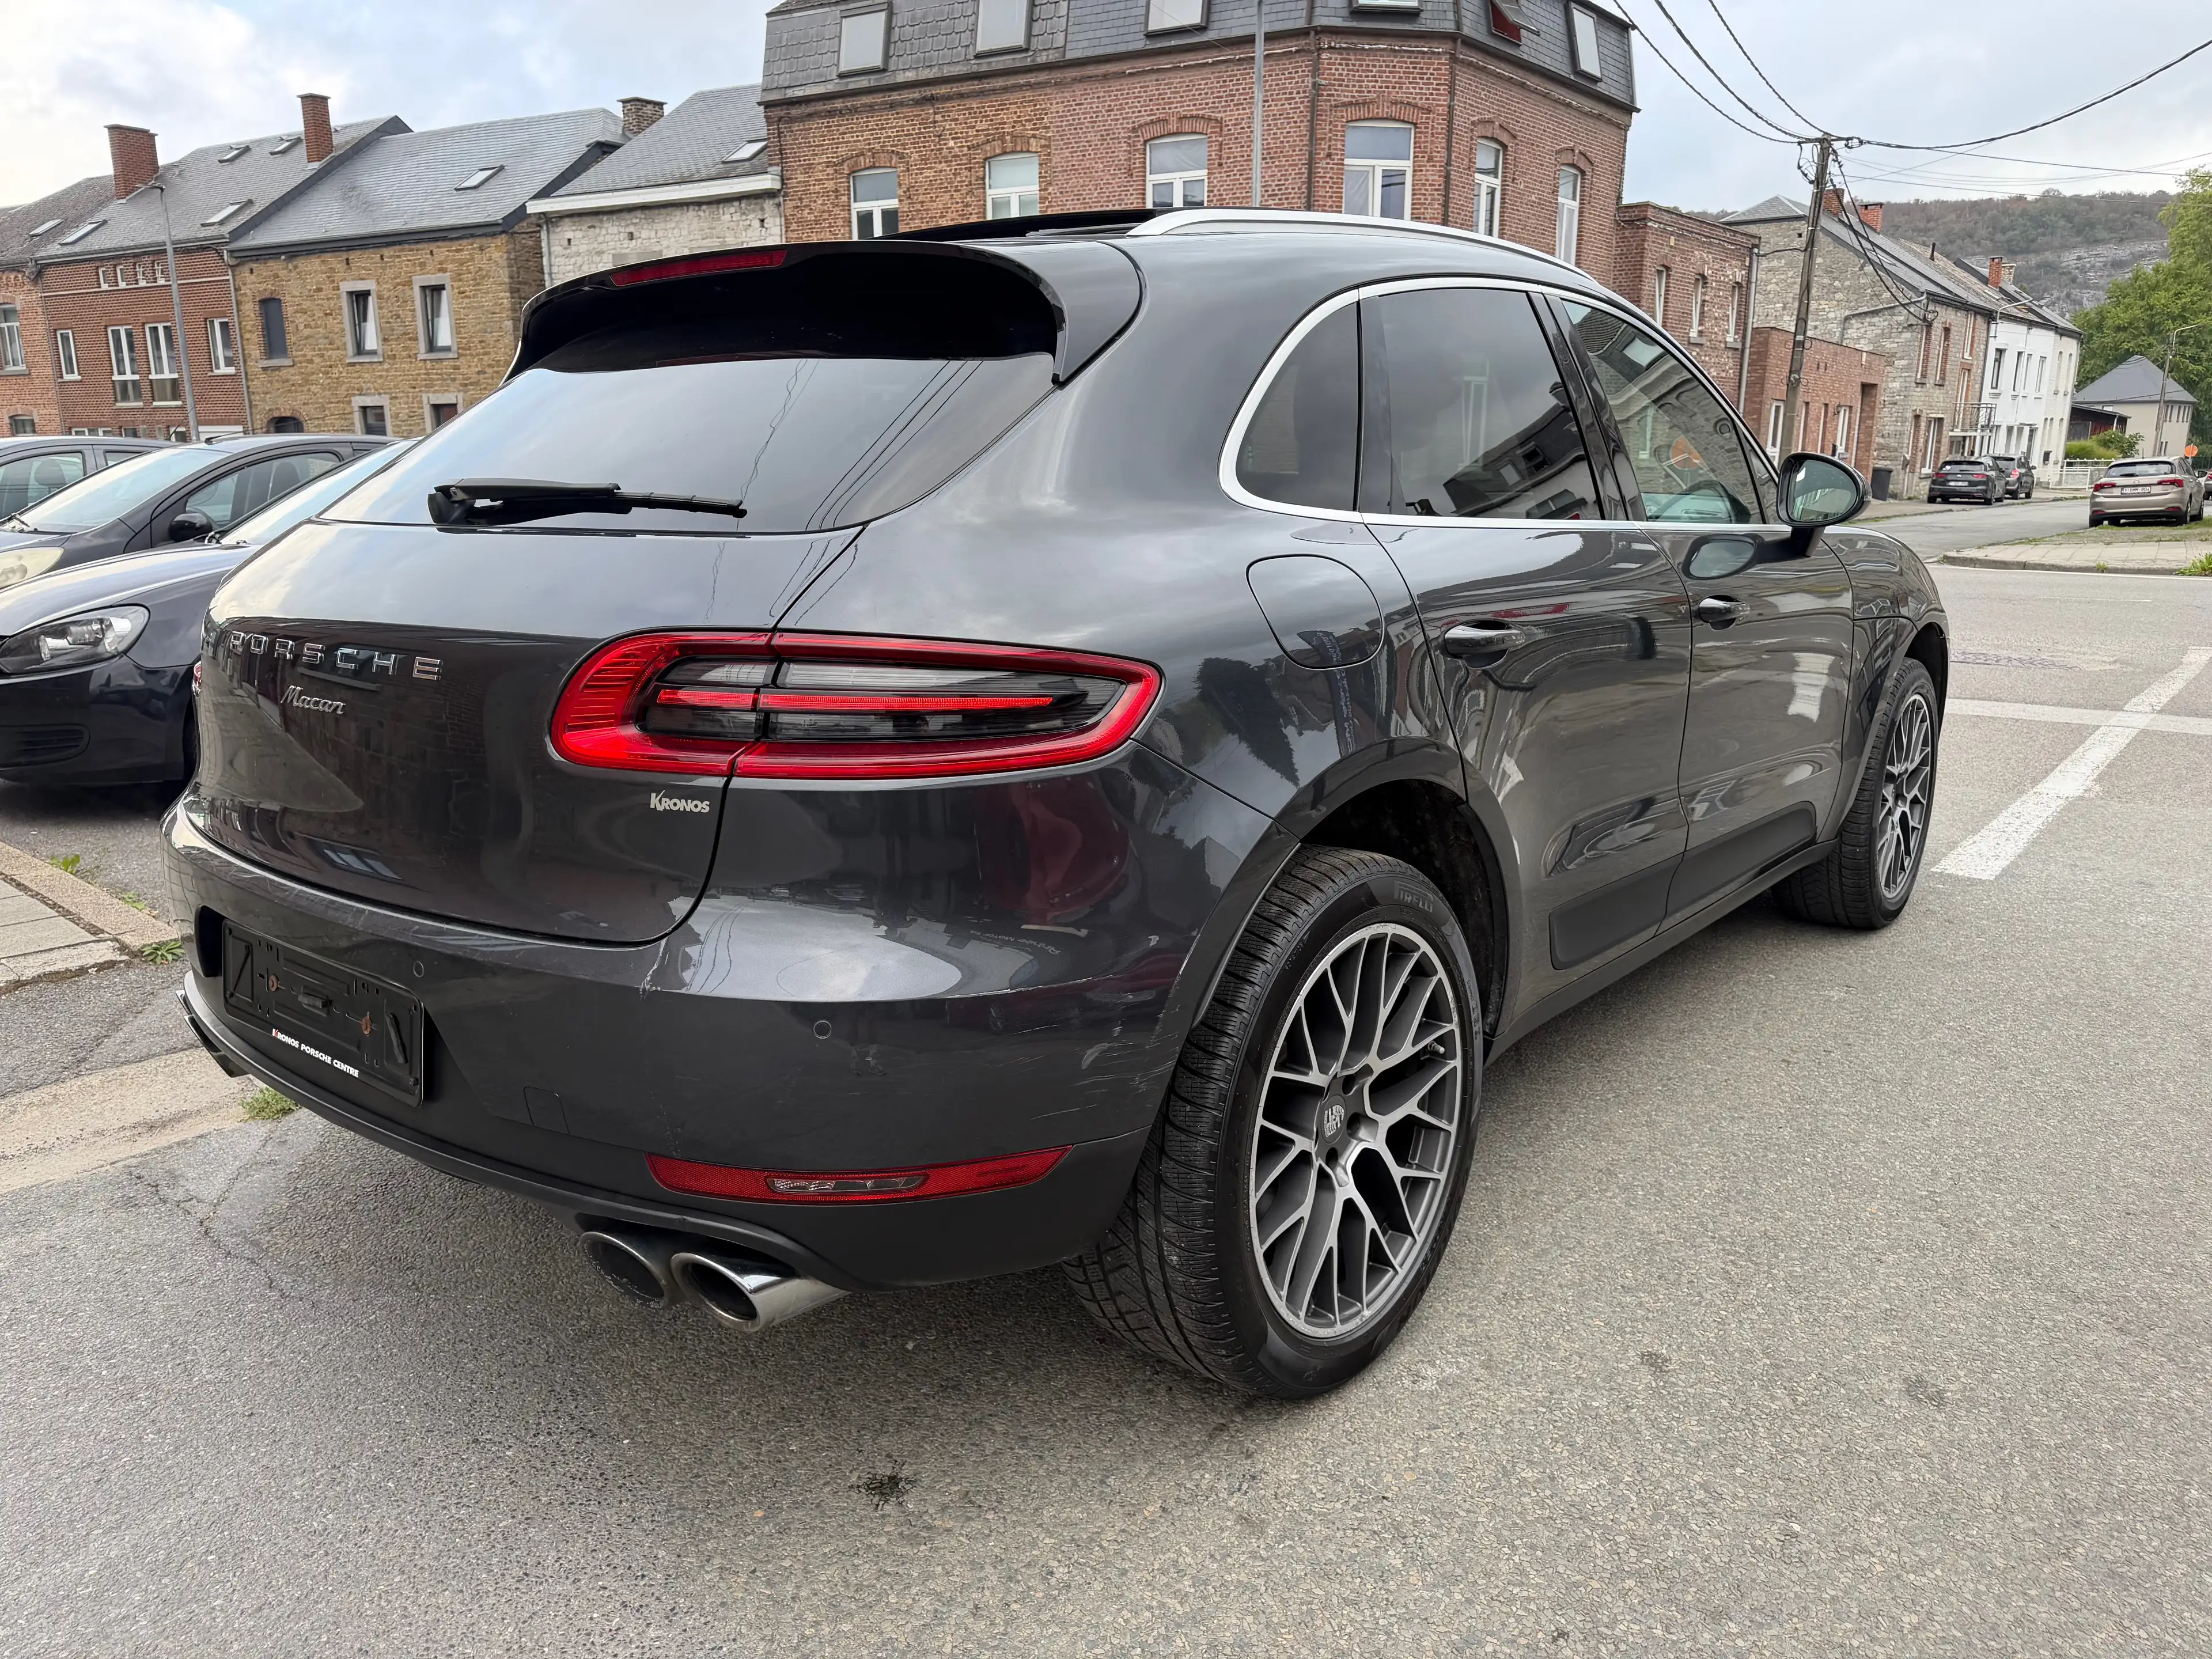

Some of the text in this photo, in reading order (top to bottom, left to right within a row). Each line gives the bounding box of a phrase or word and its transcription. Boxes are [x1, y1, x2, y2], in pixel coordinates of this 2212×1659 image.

[230, 631, 443, 680] PORSCHE
[281, 685, 346, 715] Macan
[650, 790, 710, 813] KRONOS
[1394, 880, 1434, 912] PIRELLI
[272, 1028, 359, 1078] KRONOS PORSCHE CENTRE
